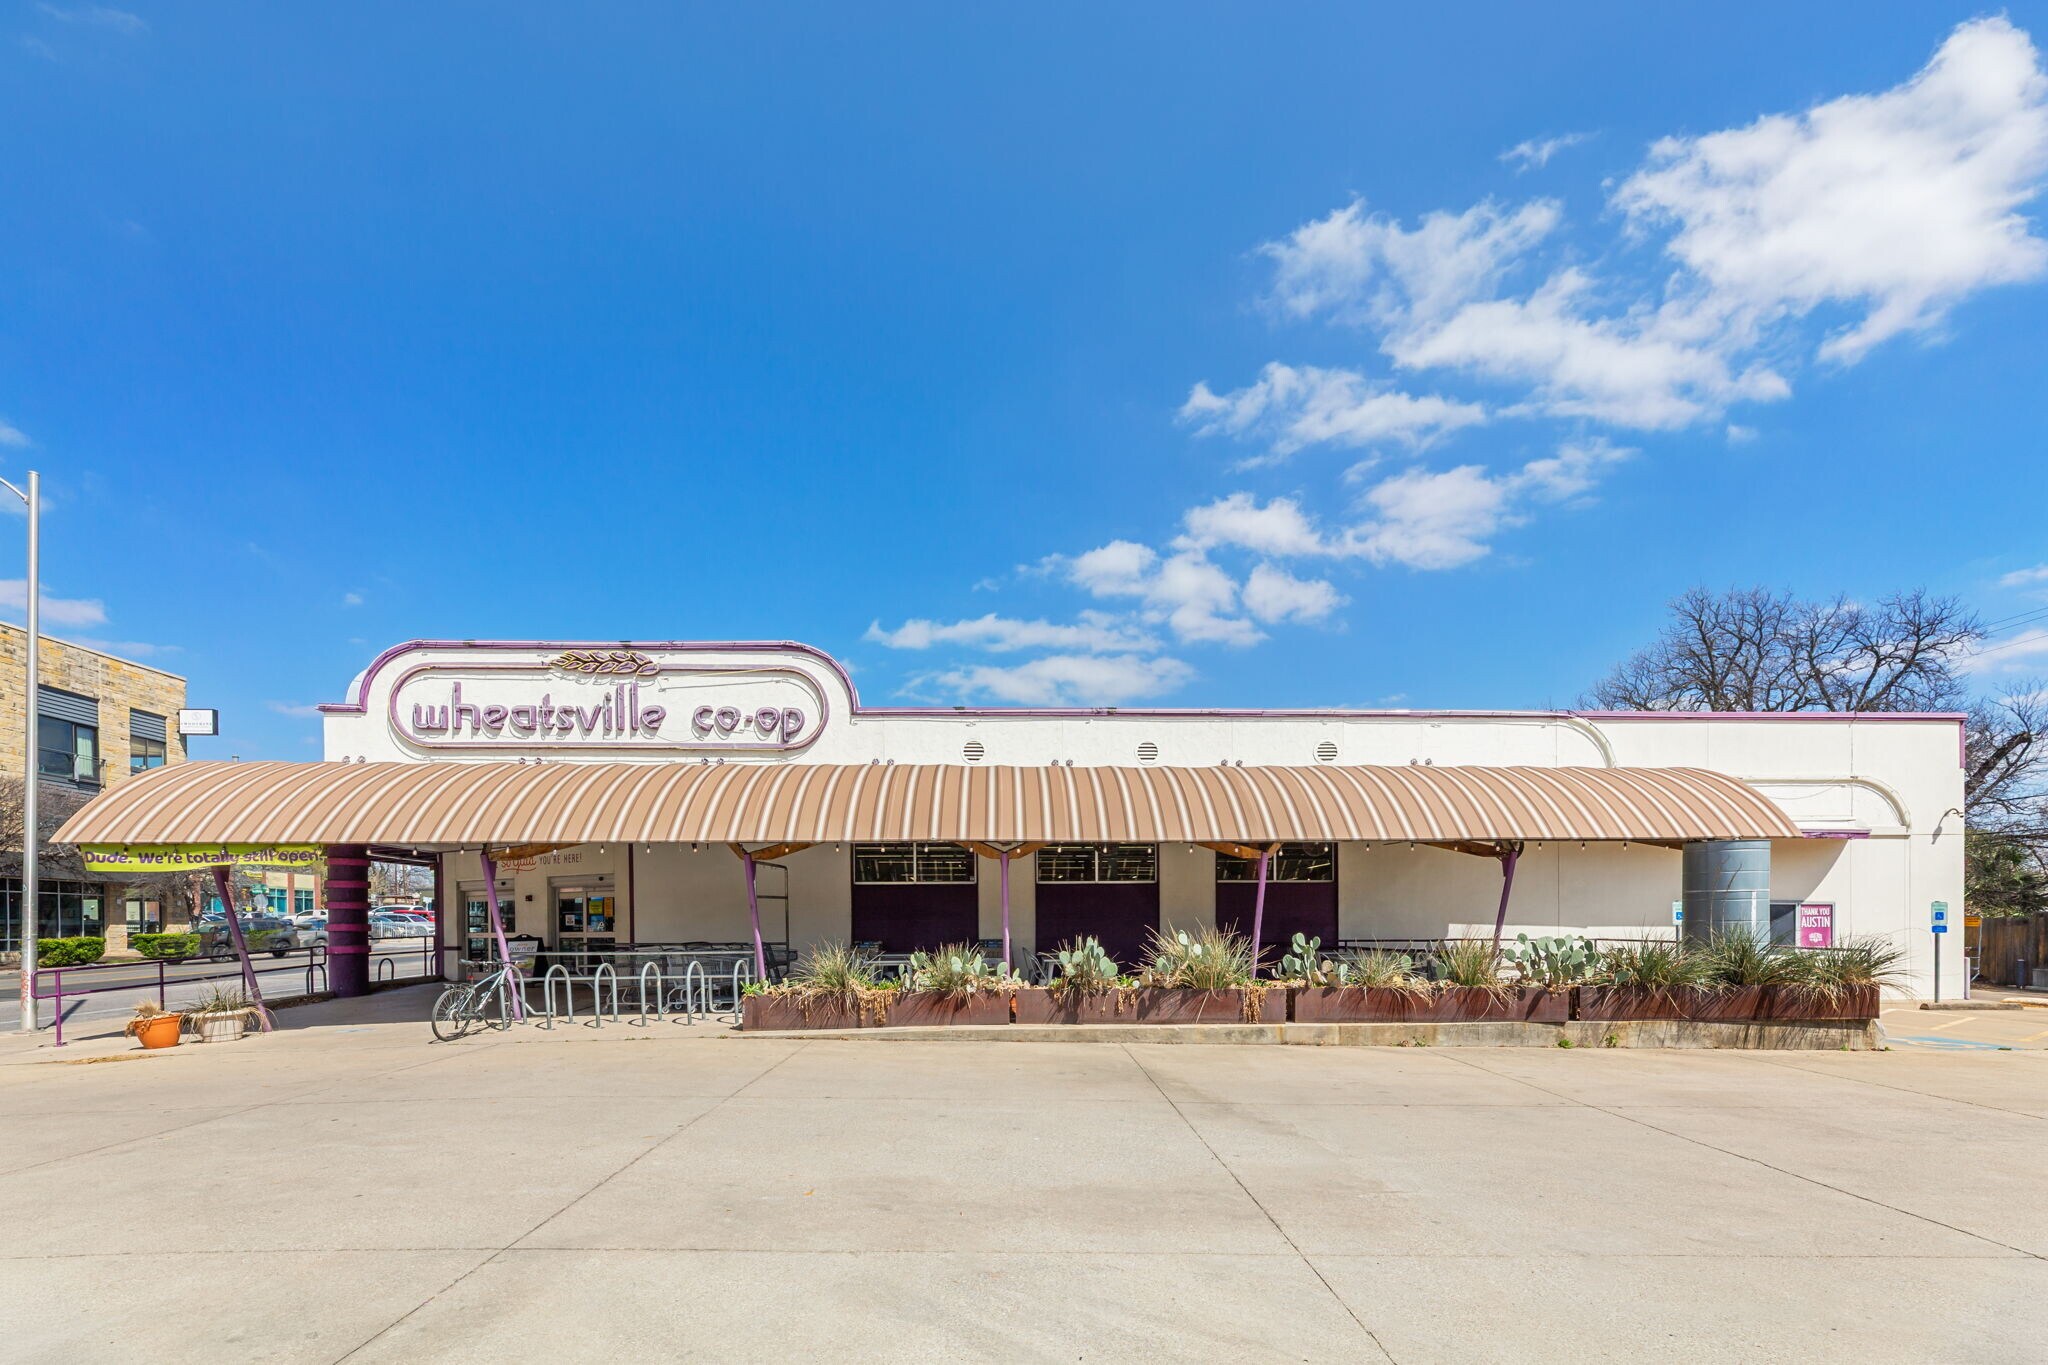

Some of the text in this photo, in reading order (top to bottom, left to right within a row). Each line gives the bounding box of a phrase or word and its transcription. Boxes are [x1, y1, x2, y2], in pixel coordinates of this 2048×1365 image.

[412, 682, 807, 743] wheatsville co-op
[84, 850, 132, 864] Dude.
[138, 851, 183, 864] We're
[187, 850, 240, 865] totally
[539, 854, 561, 865] YOU'RE
[563, 852, 582, 864] HERE!
[1801, 907, 1830, 916] THANK YOU
[1801, 916, 1831, 928] AUSTIN
